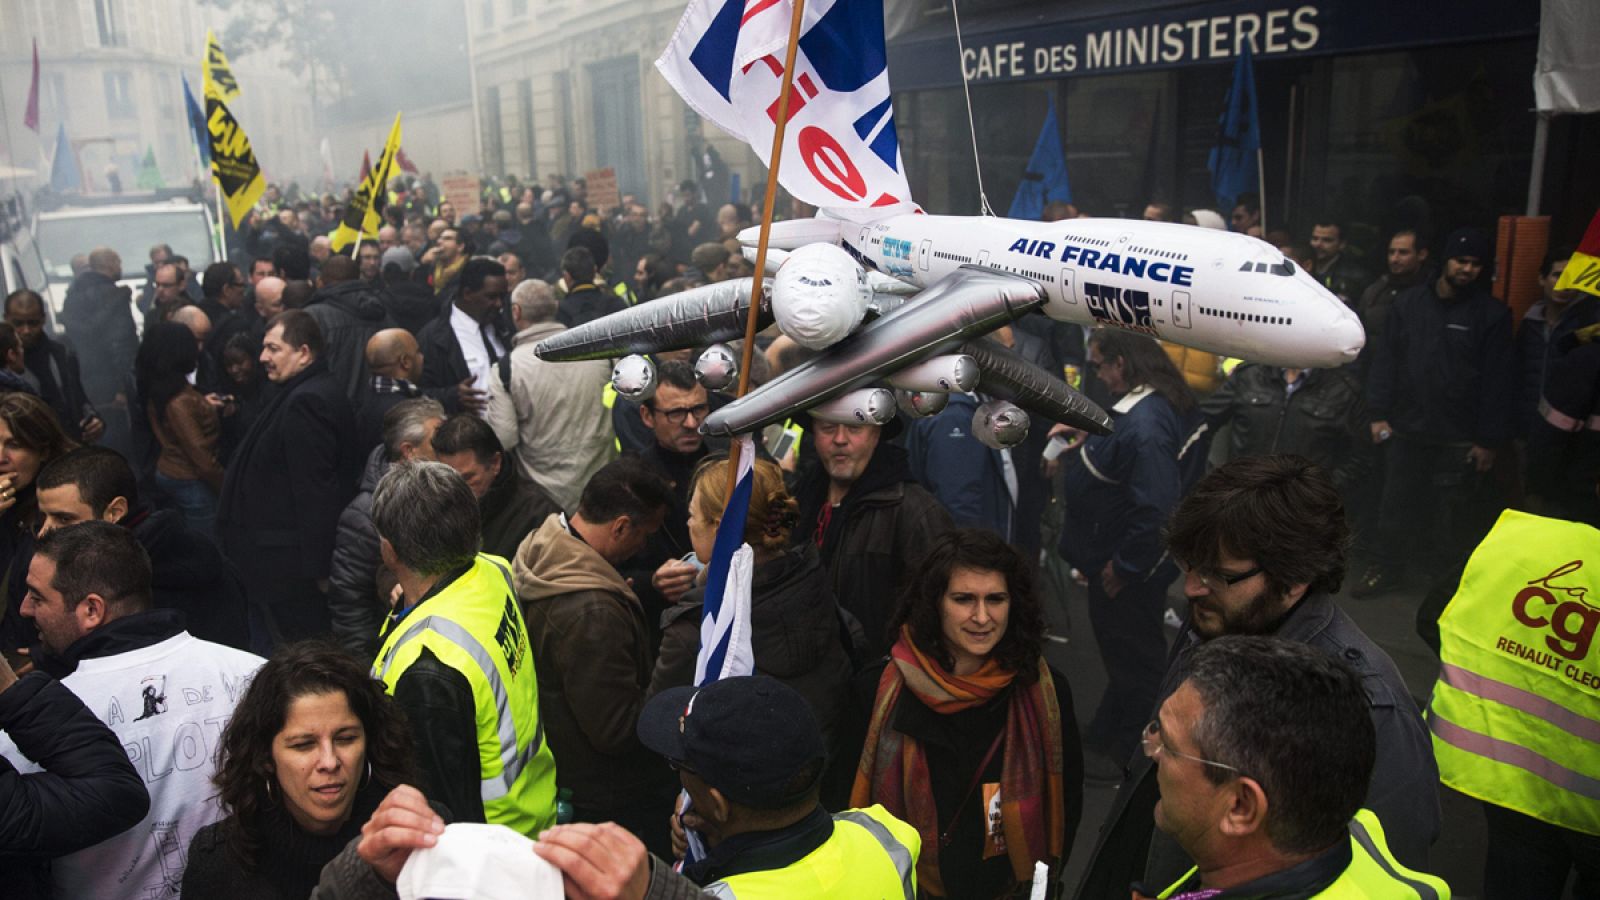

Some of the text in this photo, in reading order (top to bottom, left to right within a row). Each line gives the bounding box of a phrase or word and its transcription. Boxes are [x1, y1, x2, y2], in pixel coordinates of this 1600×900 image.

[962, 7, 1321, 81] CAFE DES MINISTERES
[1008, 237, 1195, 287] AIR FRANCE
[1511, 586, 1600, 661] cg
[1496, 636, 1564, 672] RENAULT
[109, 695, 125, 726] A
[182, 684, 214, 706] DE
